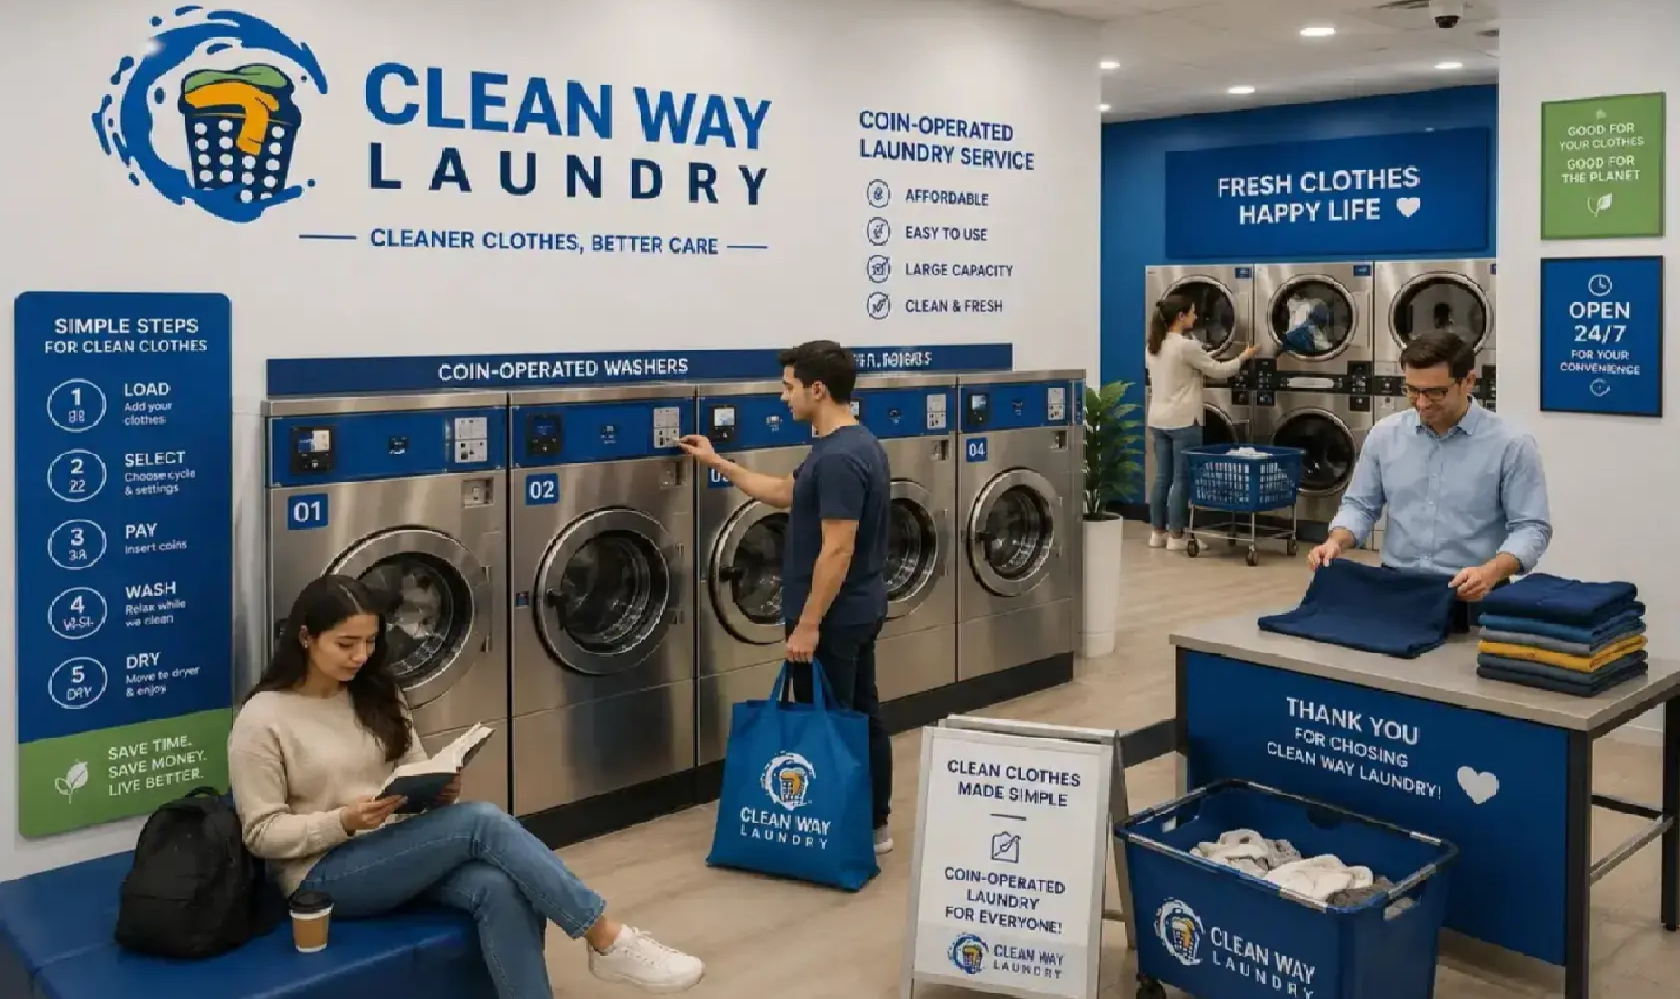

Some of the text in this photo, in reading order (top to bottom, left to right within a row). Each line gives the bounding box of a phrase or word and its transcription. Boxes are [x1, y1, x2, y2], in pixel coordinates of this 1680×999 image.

[365, 61, 772, 150] CLEAN WAY
[859, 111, 1013, 142] COIN-OPERATED
[1568, 122, 1635, 136] GOOD FOR
[1560, 136, 1644, 151] YOUR CLOTHES
[859, 139, 1035, 171] LAUNDRY SERVICE
[1567, 155, 1635, 170] GOOD FOR
[368, 142, 767, 206] LAUNDRY
[1217, 165, 1421, 198] FRESH CLOTHES
[1561, 169, 1641, 183] THE PLANET
[906, 189, 989, 206] AFFORDABLE
[1239, 198, 1381, 225] HAPPY LIFE
[370, 228, 719, 255] CLEANER CLOTHES, BETTER CARE
[906, 226, 988, 241] EASY TO USE
[905, 263, 1013, 277] LARGE CAPACITY
[905, 299, 1003, 313] CLEAN & FRESH
[1569, 301, 1630, 319] OPEN
[54, 318, 199, 334] SIMPLE STEPS
[1574, 325, 1627, 344] 24/7
[45, 339, 208, 354] FOR CLEAN CLOTHES
[1571, 350, 1630, 360] FOR YOUR
[437, 358, 689, 381] COIN-OPERATED WASHERS
[70, 387, 81, 406] 1
[124, 382, 170, 397] LOAD
[124, 402, 173, 415] Add your
[124, 416, 166, 426] clothes
[968, 442, 986, 457] 04
[70, 458, 84, 475] 2
[124, 451, 186, 468] SELECT
[124, 469, 196, 483] Choose cycle
[710, 468, 729, 483] 0
[124, 483, 179, 496] & settings
[529, 480, 555, 499] 02
[292, 501, 322, 522] 01
[70, 528, 85, 547] 3
[125, 523, 158, 539] PAY
[125, 540, 187, 554] Insert coins
[125, 581, 176, 599] WASH
[70, 595, 85, 614] 4
[125, 599, 187, 615] Relax while
[126, 652, 161, 669] DRY
[71, 665, 85, 683] 5
[126, 667, 200, 684] Move to dryer
[126, 684, 167, 697] & enjoy
[1286, 696, 1421, 745] THANK YOU
[108, 735, 193, 761] SAVE TIME.
[1295, 727, 1409, 768] FOR CHOSING
[108, 750, 208, 779] SAVE MONEY.
[947, 759, 1082, 787] CLEAN CLOTHES
[1267, 741, 1442, 801] CLEAN WAY LAUNDRY!
[108, 768, 204, 796] LIVE BETTER.
[957, 781, 1069, 807] MADE SIMPLE
[740, 806, 832, 836] CLEAN WAY
[740, 824, 828, 850] LAUNDRY
[944, 866, 1066, 895] COIN-OPERATED
[966, 889, 1040, 910] LAUNDRY
[945, 906, 1063, 934] FOR EVERYONE!
[993, 944, 1064, 966] CLEAN WAY
[1211, 926, 1316, 985] CLEAN WAY
[993, 959, 1063, 979] LAUNDRY
[1212, 951, 1314, 999] LAUNDRY
